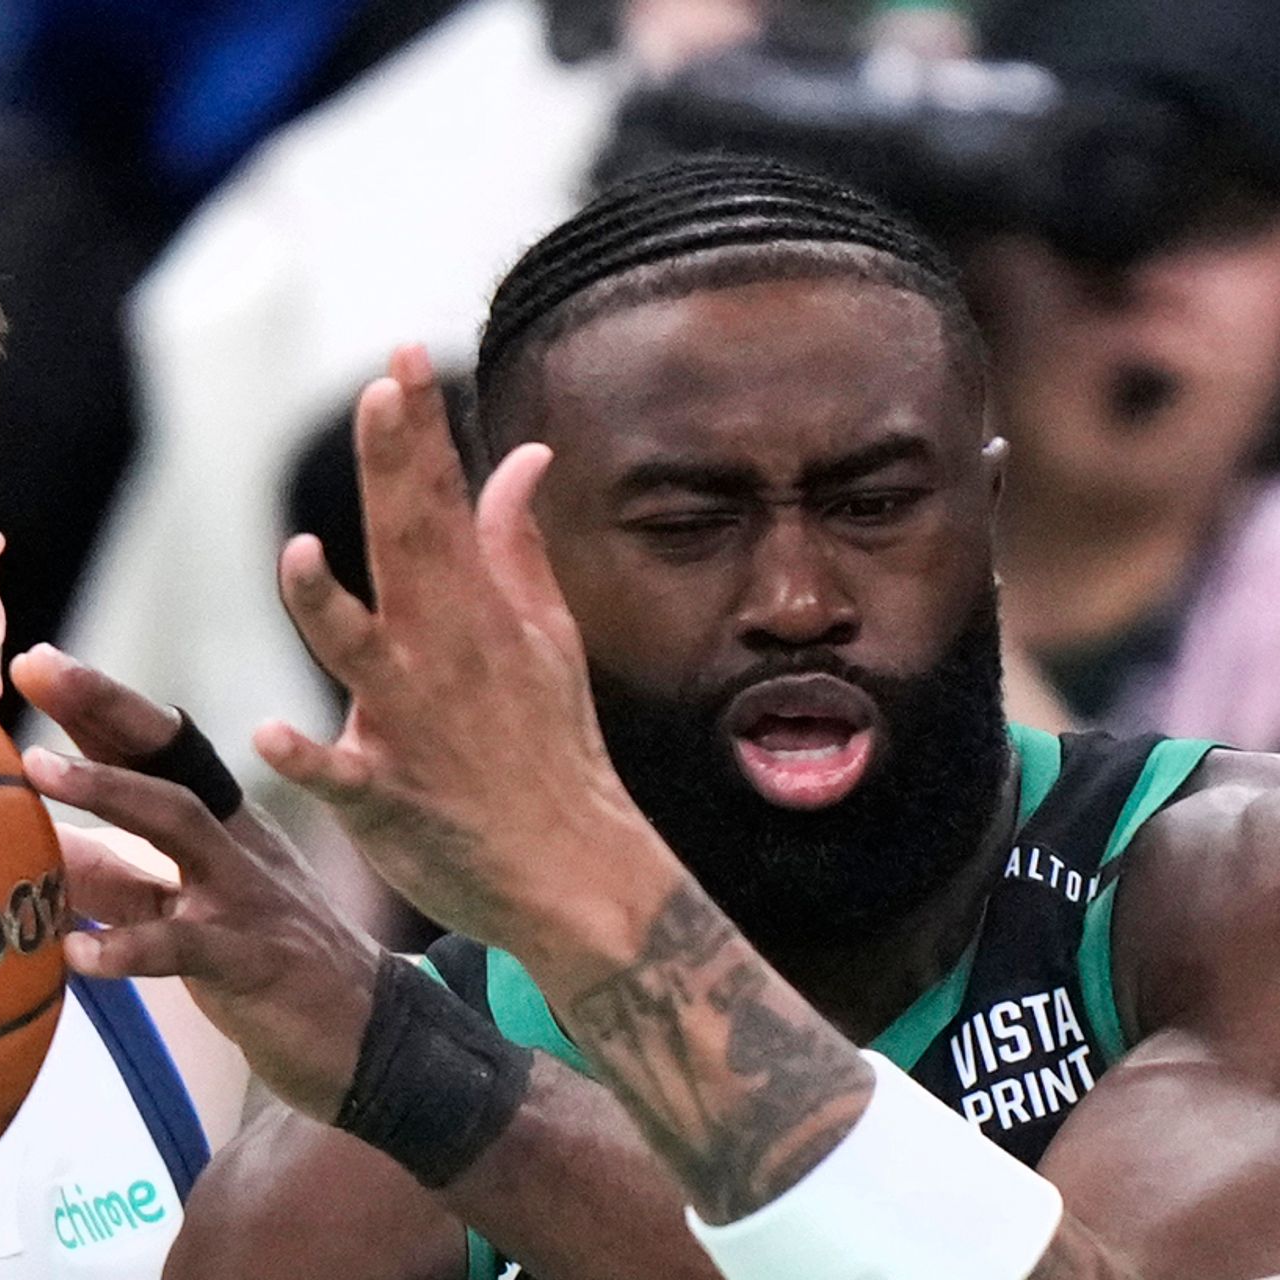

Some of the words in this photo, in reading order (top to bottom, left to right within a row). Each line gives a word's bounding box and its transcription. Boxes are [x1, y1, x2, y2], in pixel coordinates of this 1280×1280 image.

[950, 986, 1085, 1089] VISTA
[961, 1044, 1096, 1130] PRINT
[54, 1179, 166, 1249] chime
